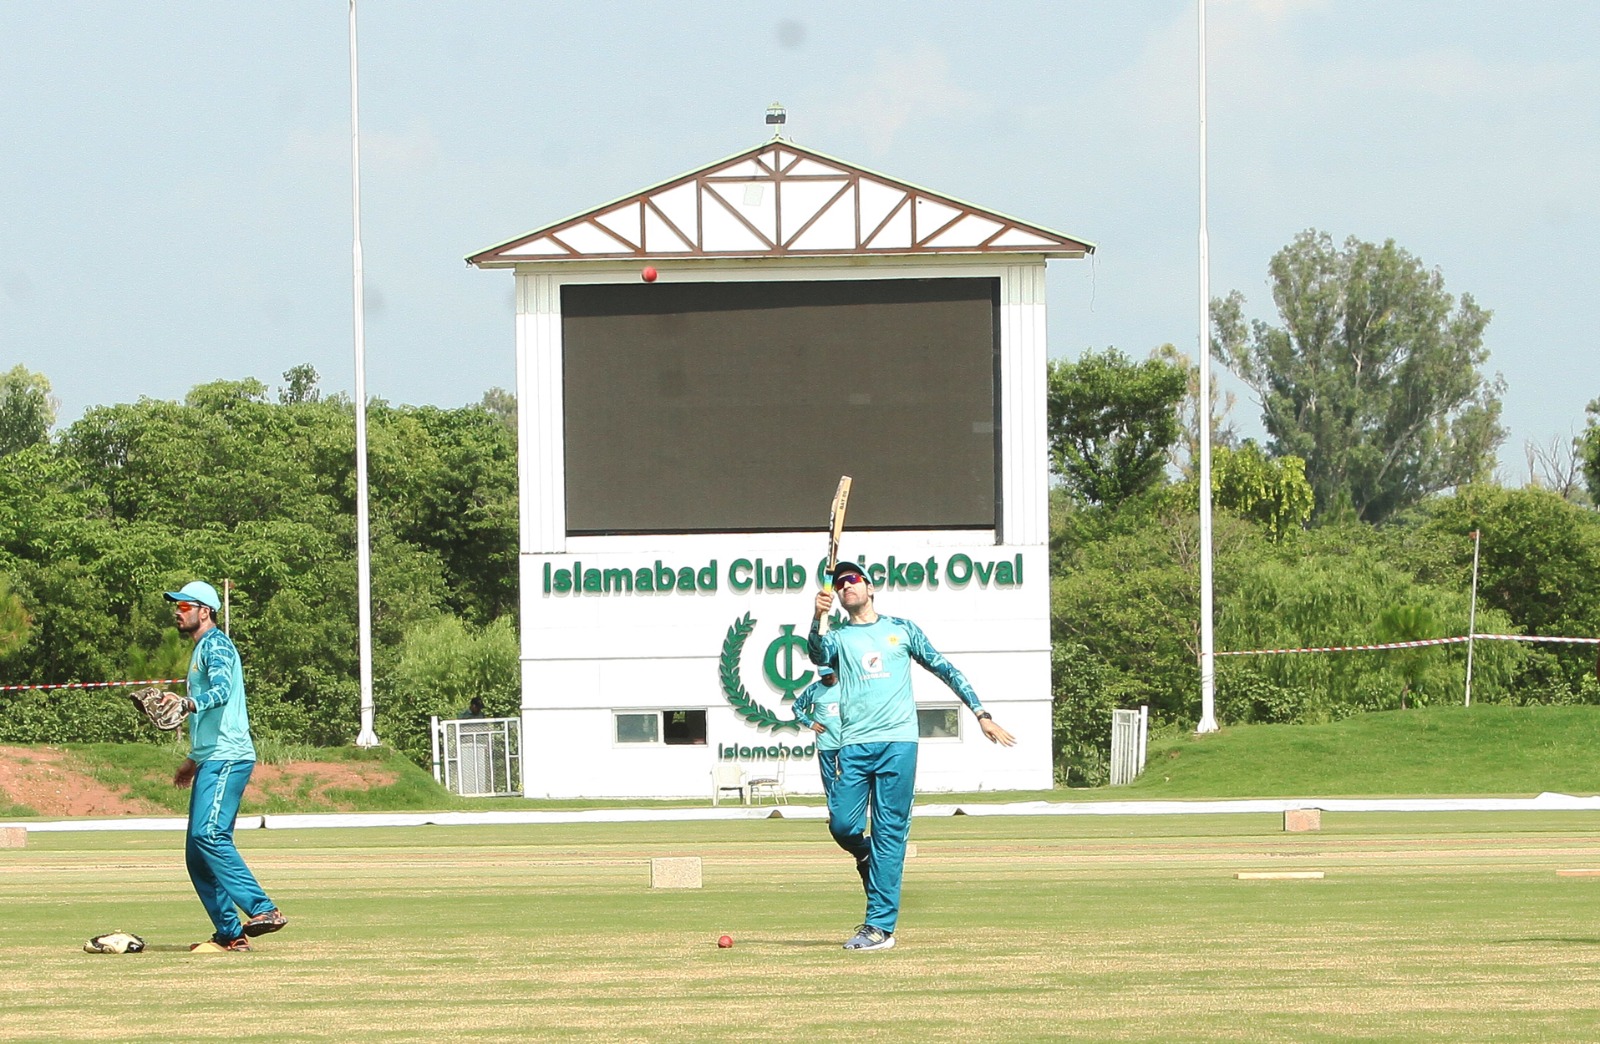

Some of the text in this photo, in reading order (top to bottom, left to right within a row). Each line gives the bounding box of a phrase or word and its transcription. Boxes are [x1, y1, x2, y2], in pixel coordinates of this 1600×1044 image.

[543, 553, 1023, 593] Islamabad Club cket Oval
[718, 742, 815, 760] Islamabad
